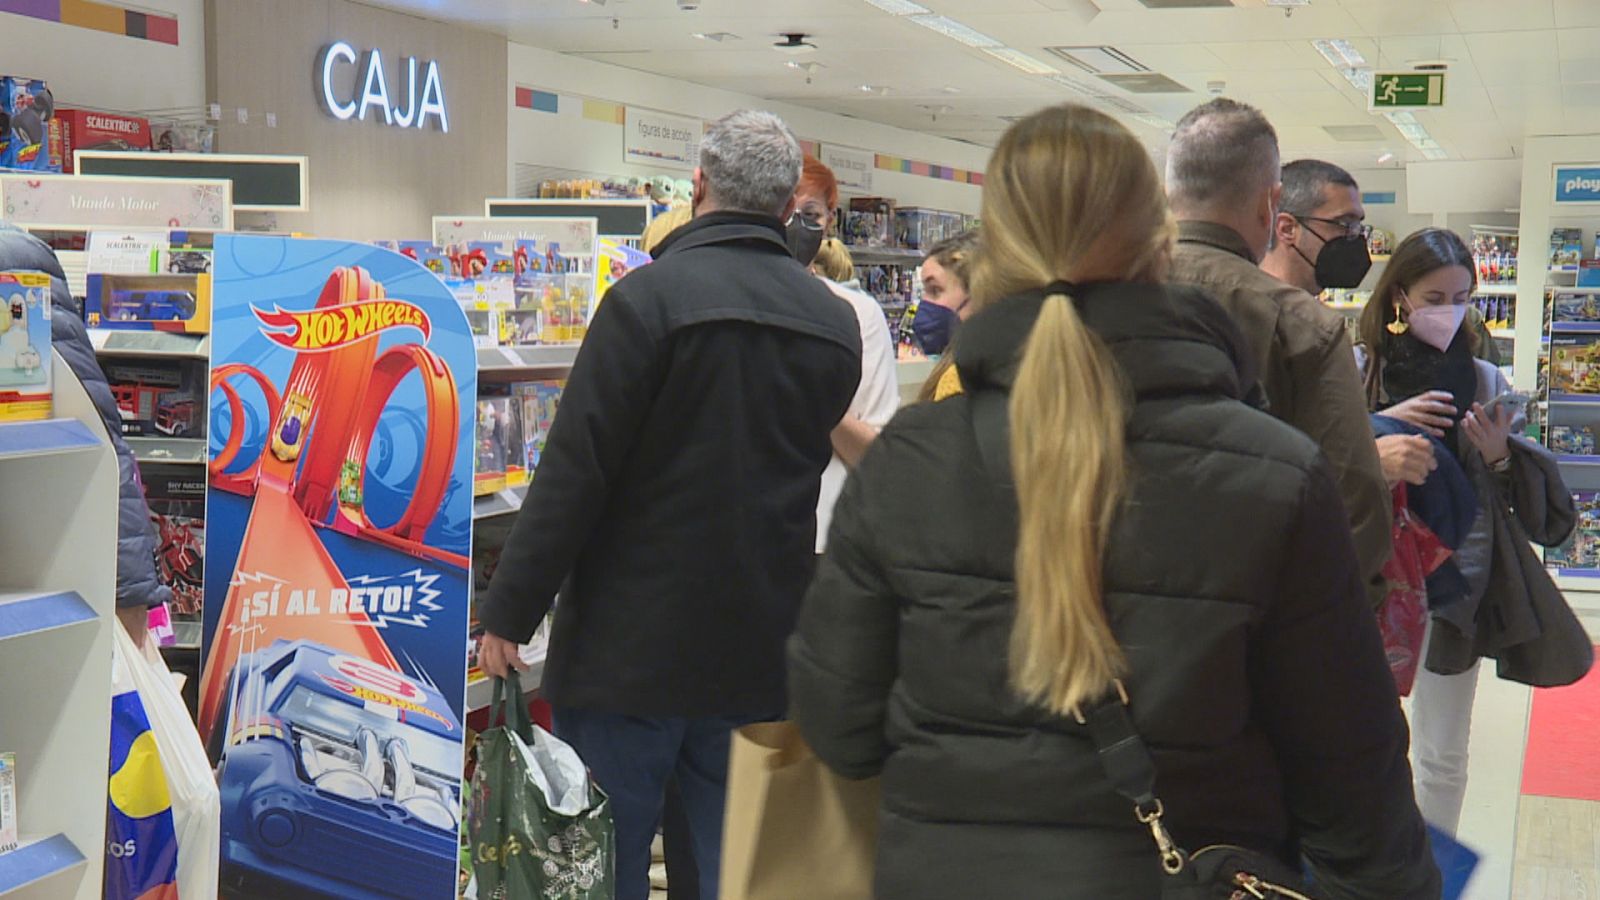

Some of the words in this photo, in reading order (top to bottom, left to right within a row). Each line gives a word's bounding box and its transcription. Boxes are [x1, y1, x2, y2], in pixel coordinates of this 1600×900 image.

[322, 41, 449, 134] CAJA
[86, 115, 132, 133] SCALEXTRIC
[638, 119, 661, 138] figuras
[662, 126, 671, 139] de
[69, 194, 115, 209] Mundo
[119, 196, 160, 211] Motor
[481, 231, 515, 241] Mundo
[516, 232, 546, 242] Motor
[286, 588, 320, 616] AL
[329, 585, 413, 614] RETO!
[107, 839, 137, 858] os
